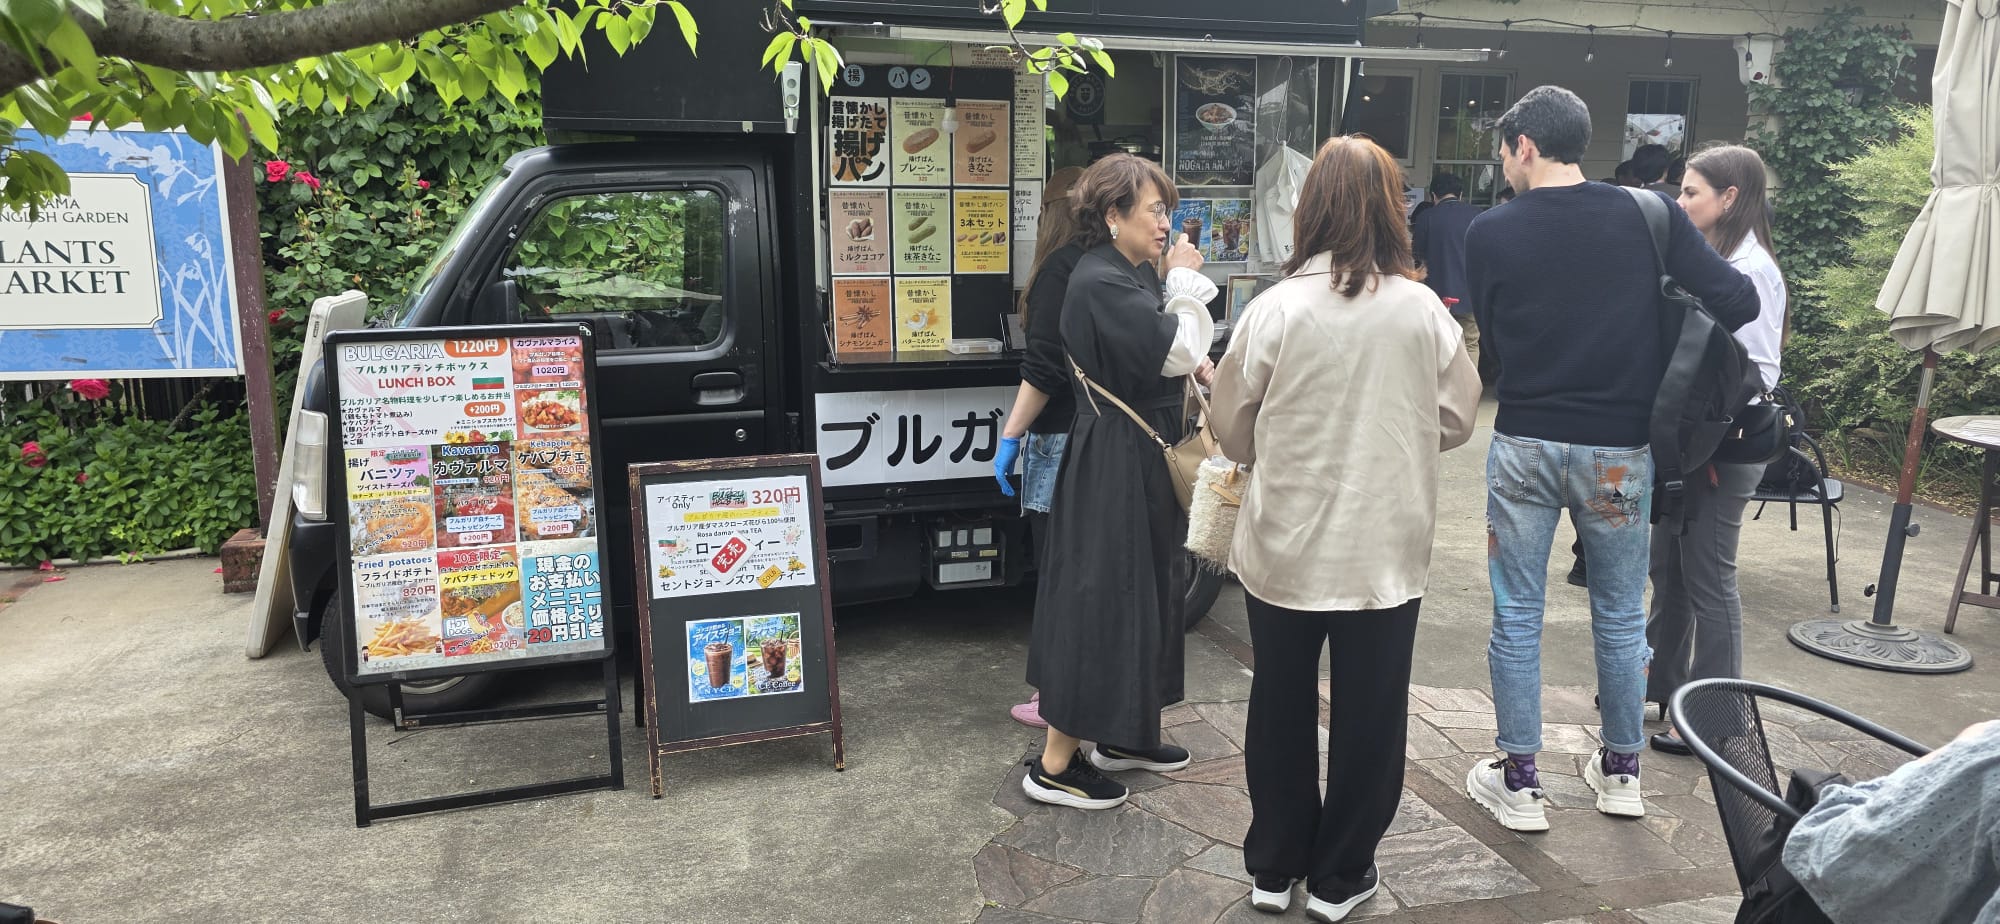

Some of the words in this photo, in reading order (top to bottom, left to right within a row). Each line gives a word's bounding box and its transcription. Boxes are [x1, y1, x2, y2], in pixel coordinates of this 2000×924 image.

[832, 101, 885, 114] 昔懐かし
[832, 115, 886, 129] 揚げたて
[968, 163, 993, 173] きなこ
[0, 212, 57, 222] NGLSH
[63, 212, 128, 223] GARDEN
[960, 218, 1005, 228] 3本セット
[839, 252, 885, 262] ミルクココア
[904, 252, 942, 261] 抹茶きなこ
[0, 270, 130, 294] ARKET
[344, 343, 444, 361] BULGARIA
[453, 339, 499, 354] 1220円
[356, 361, 489, 374] ブルガリアランチボックス
[536, 366, 565, 374] 1020円
[378, 377, 424, 389] LUNCH
[427, 376, 456, 387] BOX
[821, 408, 1003, 470] ブルガ
[442, 445, 499, 456] Kavarma
[434, 460, 509, 476] カヴァルマ
[557, 465, 585, 474] 920円
[657, 494, 704, 503] アイスティー
[752, 486, 800, 504] 320円
[671, 502, 691, 510] Only
[696, 539, 781, 554] ローィー
[358, 559, 384, 569] Fried
[388, 556, 433, 568] potatoes
[453, 550, 502, 564] 10食限定
[716, 542, 744, 569] 完売
[536, 554, 592, 573] 現金の
[361, 567, 432, 581] フライドポテト
[529, 571, 601, 592] お支払い
[402, 585, 436, 597] 820円
[531, 591, 602, 609] メニュー
[531, 604, 602, 627] 価格より
[528, 621, 604, 644] 20円引き
